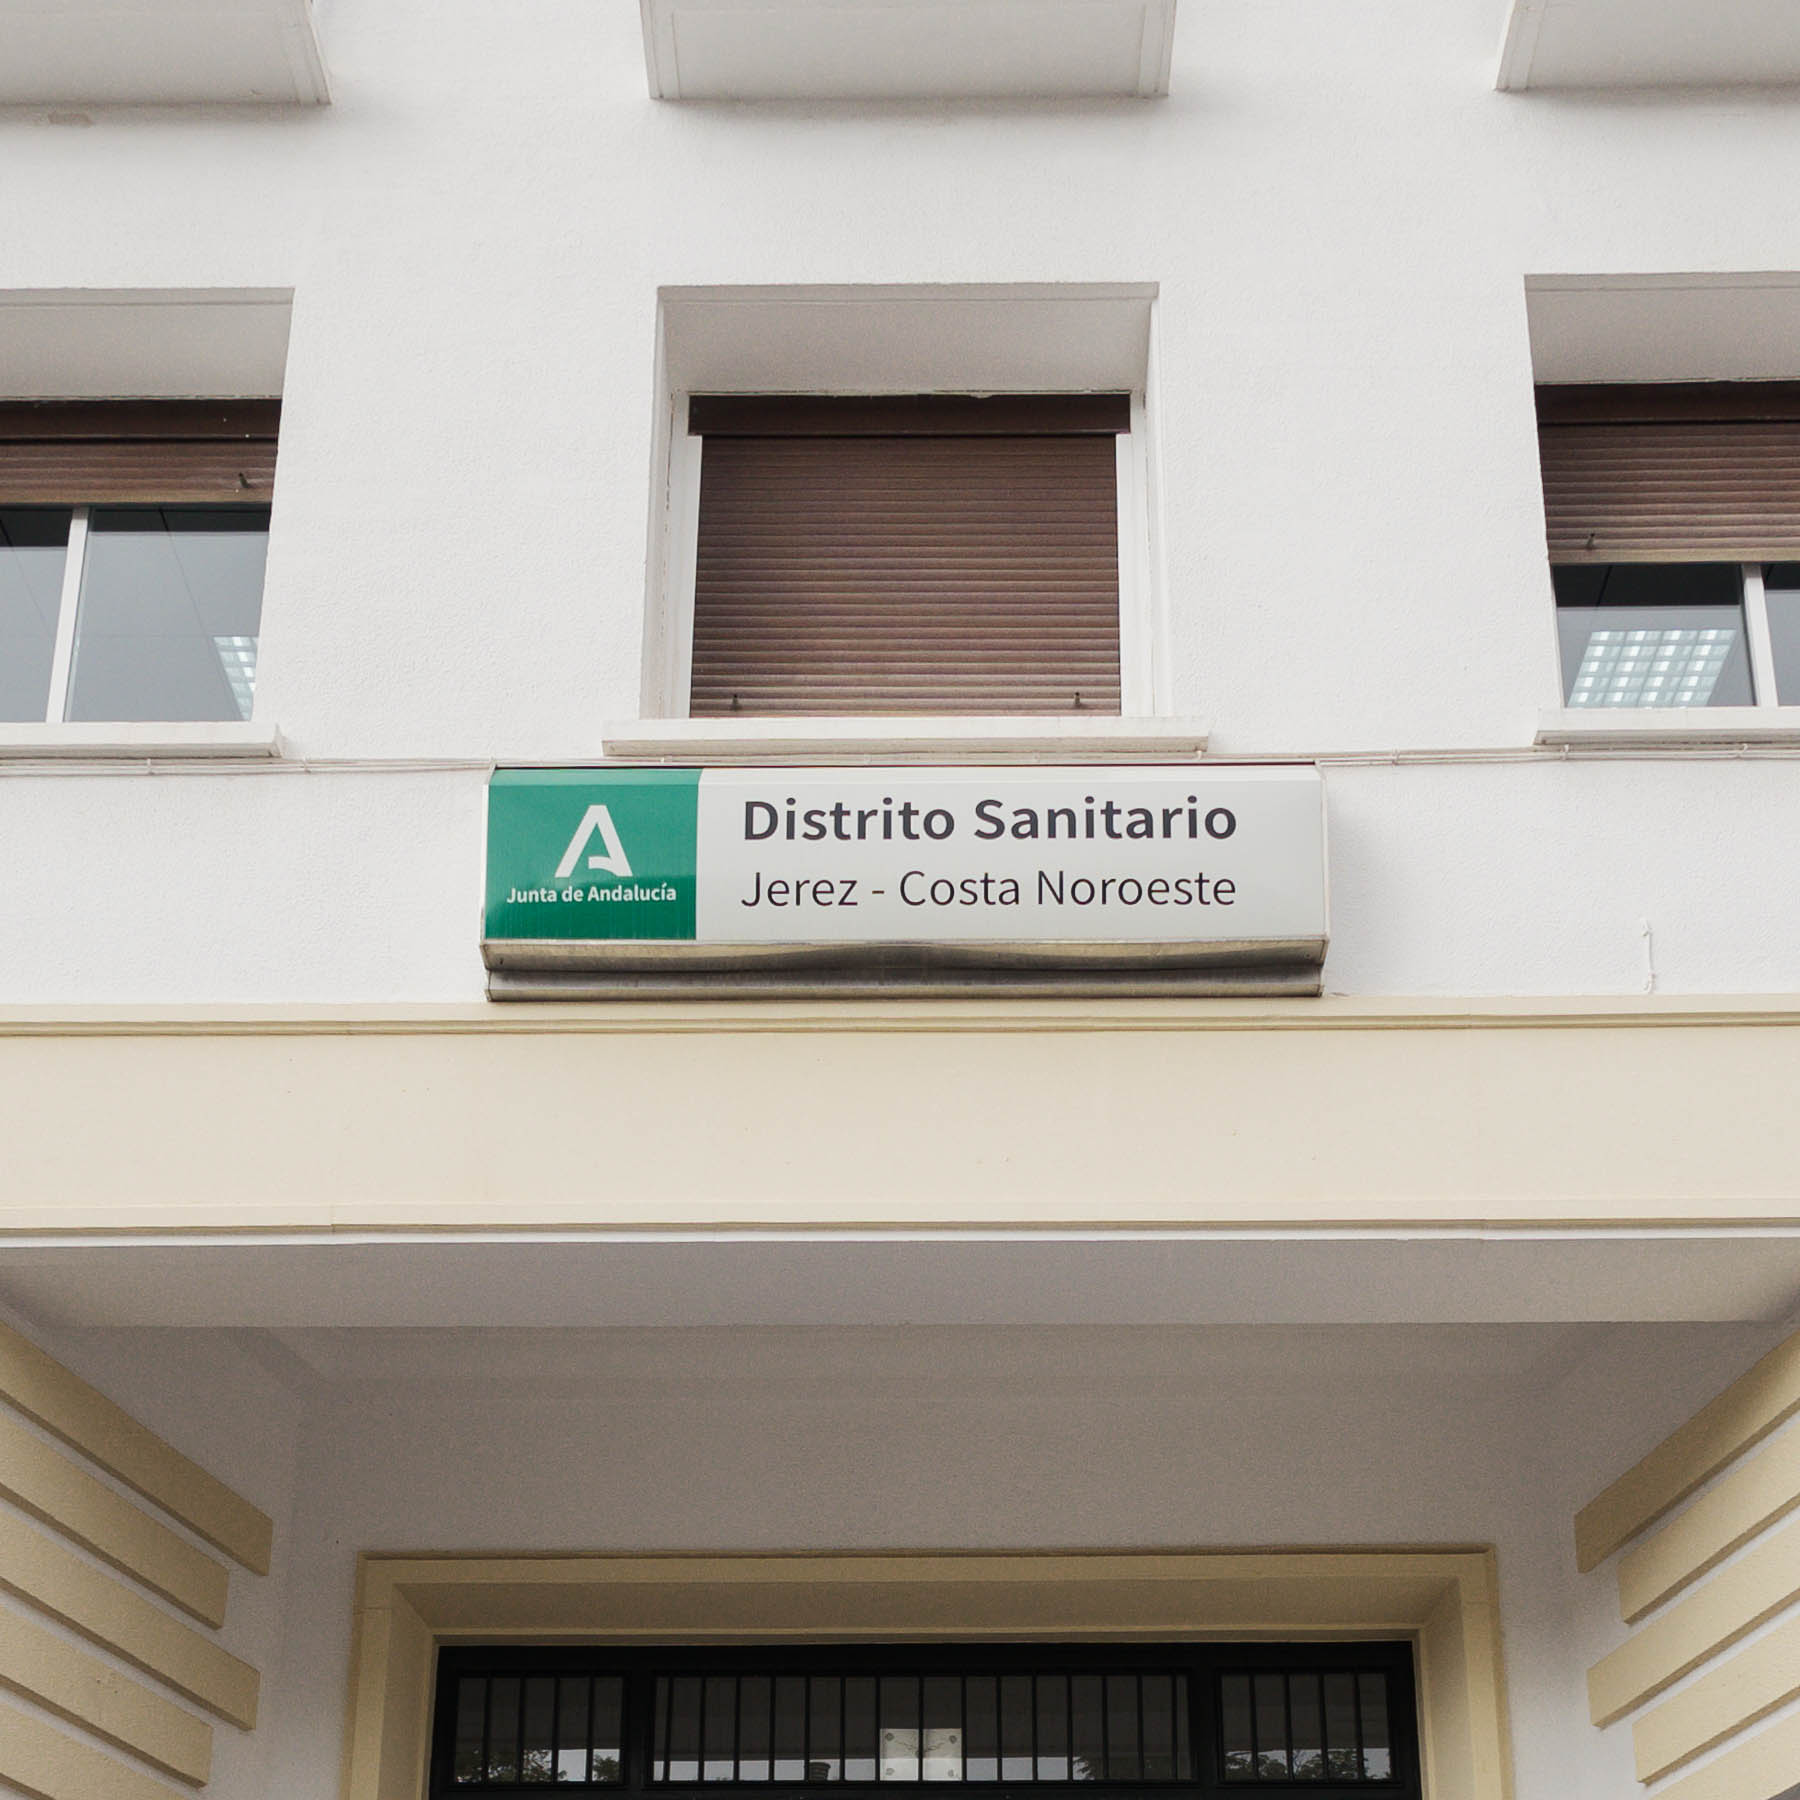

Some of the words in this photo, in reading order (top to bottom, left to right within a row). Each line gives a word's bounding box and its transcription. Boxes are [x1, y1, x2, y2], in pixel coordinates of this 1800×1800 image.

[744, 797, 955, 841] Distrito
[974, 795, 1237, 840] Sanitario
[506, 887, 557, 904] Junta
[561, 885, 584, 902] de
[587, 882, 677, 902] Andalucía
[741, 871, 859, 907] Jerez
[899, 870, 1020, 907] Costa
[1038, 870, 1236, 907] Noroeste
